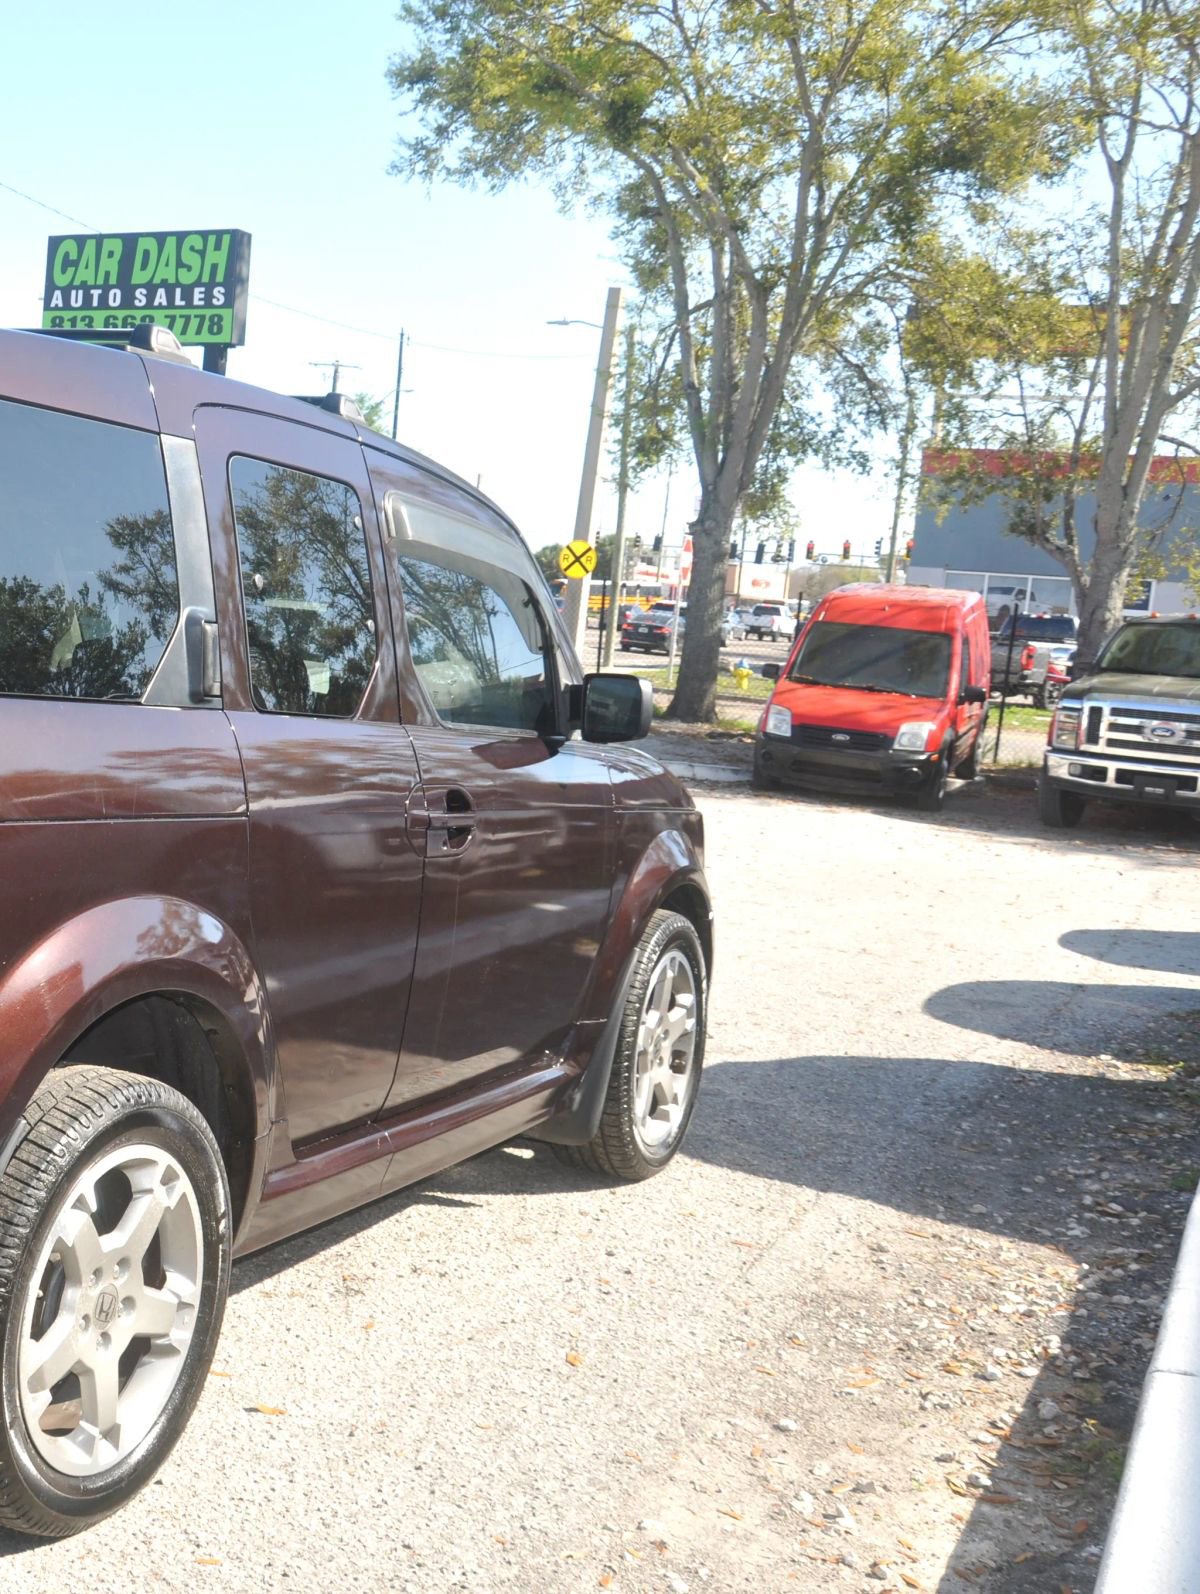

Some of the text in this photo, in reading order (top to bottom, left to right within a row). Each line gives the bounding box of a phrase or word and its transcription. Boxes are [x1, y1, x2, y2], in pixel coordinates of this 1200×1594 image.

[53, 234, 231, 287] CAR DASH
[50, 286, 226, 308] AUTO SALES
[50, 314, 94, 328] 813
[164, 313, 224, 336] 7778
[562, 553, 593, 565] R R
